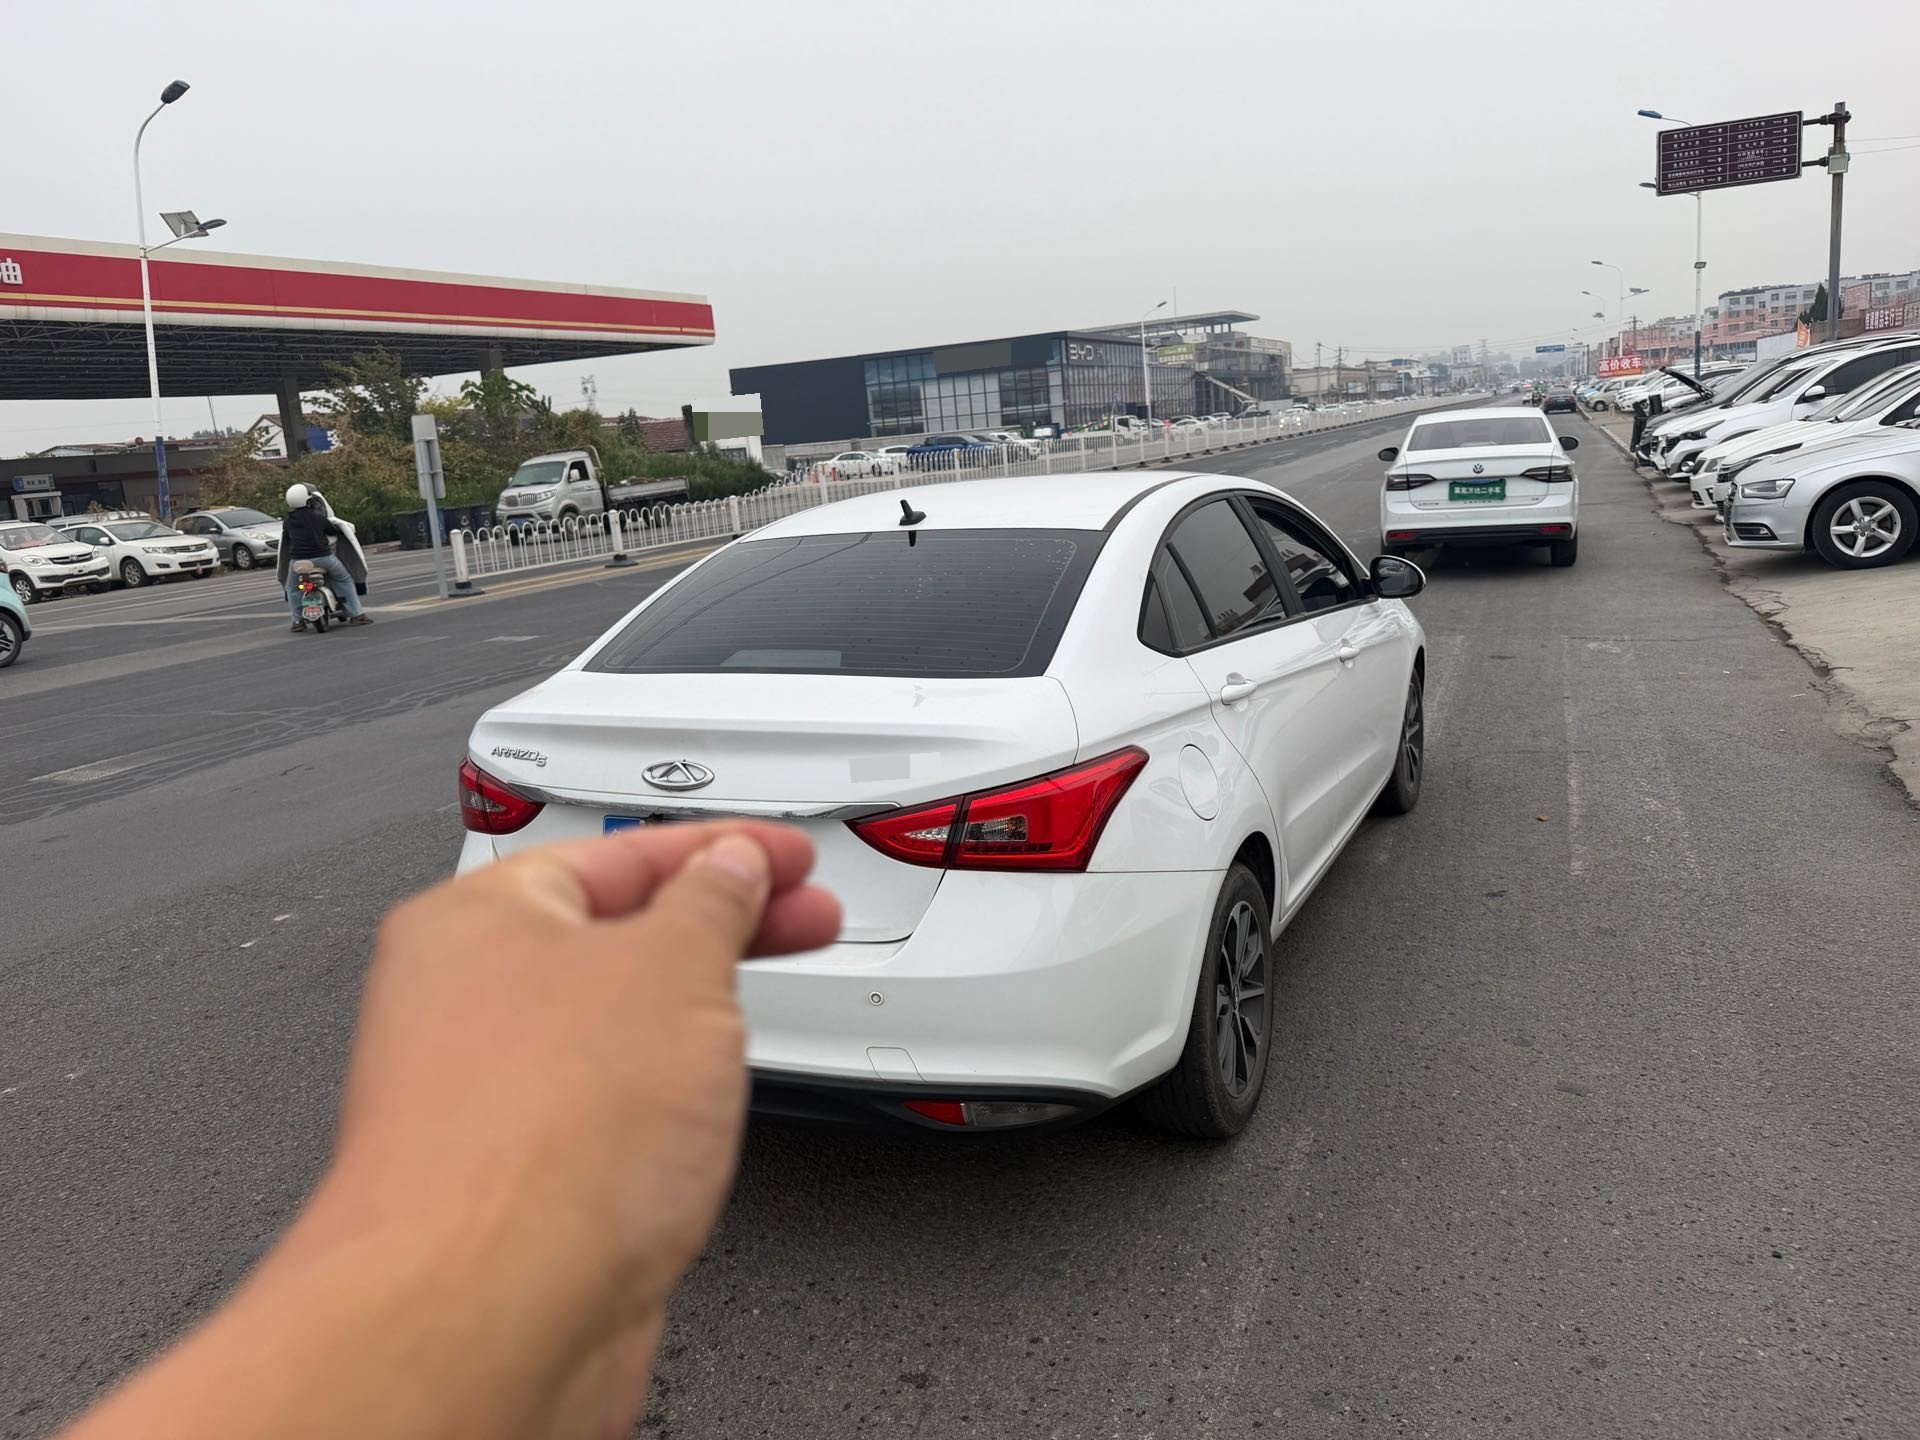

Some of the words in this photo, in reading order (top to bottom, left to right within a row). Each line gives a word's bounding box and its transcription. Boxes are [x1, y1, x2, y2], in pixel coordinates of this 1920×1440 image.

[0, 257, 23, 285] 油
[1069, 343, 1094, 360] BYD
[1599, 357, 1641, 372] 高价收车
